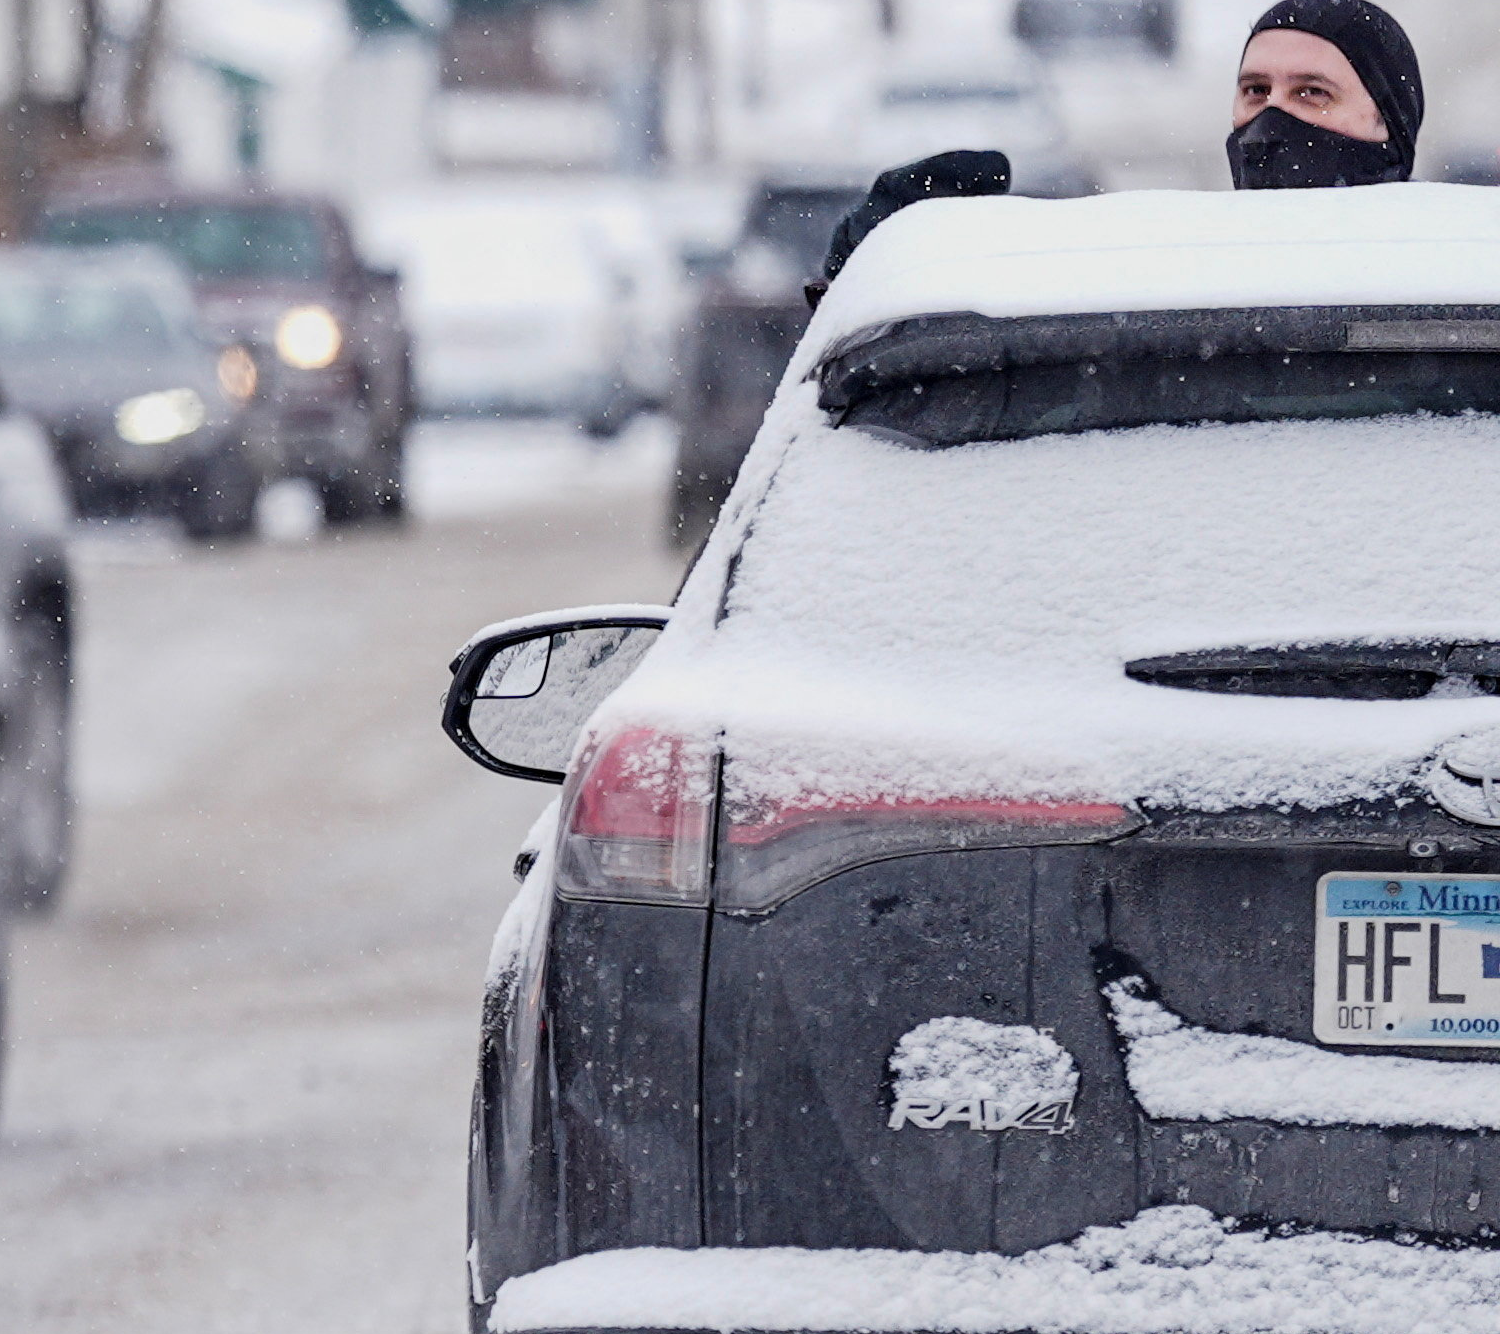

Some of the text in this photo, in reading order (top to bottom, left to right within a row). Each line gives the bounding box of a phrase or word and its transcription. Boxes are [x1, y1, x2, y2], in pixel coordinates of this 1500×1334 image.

[1342, 899, 1409, 910] EXPLORE
[1337, 921, 1467, 1004] HFL
[1337, 1006, 1376, 1030] OCT
[1429, 1017, 1500, 1035] 10,000
[887, 1097, 1075, 1135] RAV4
